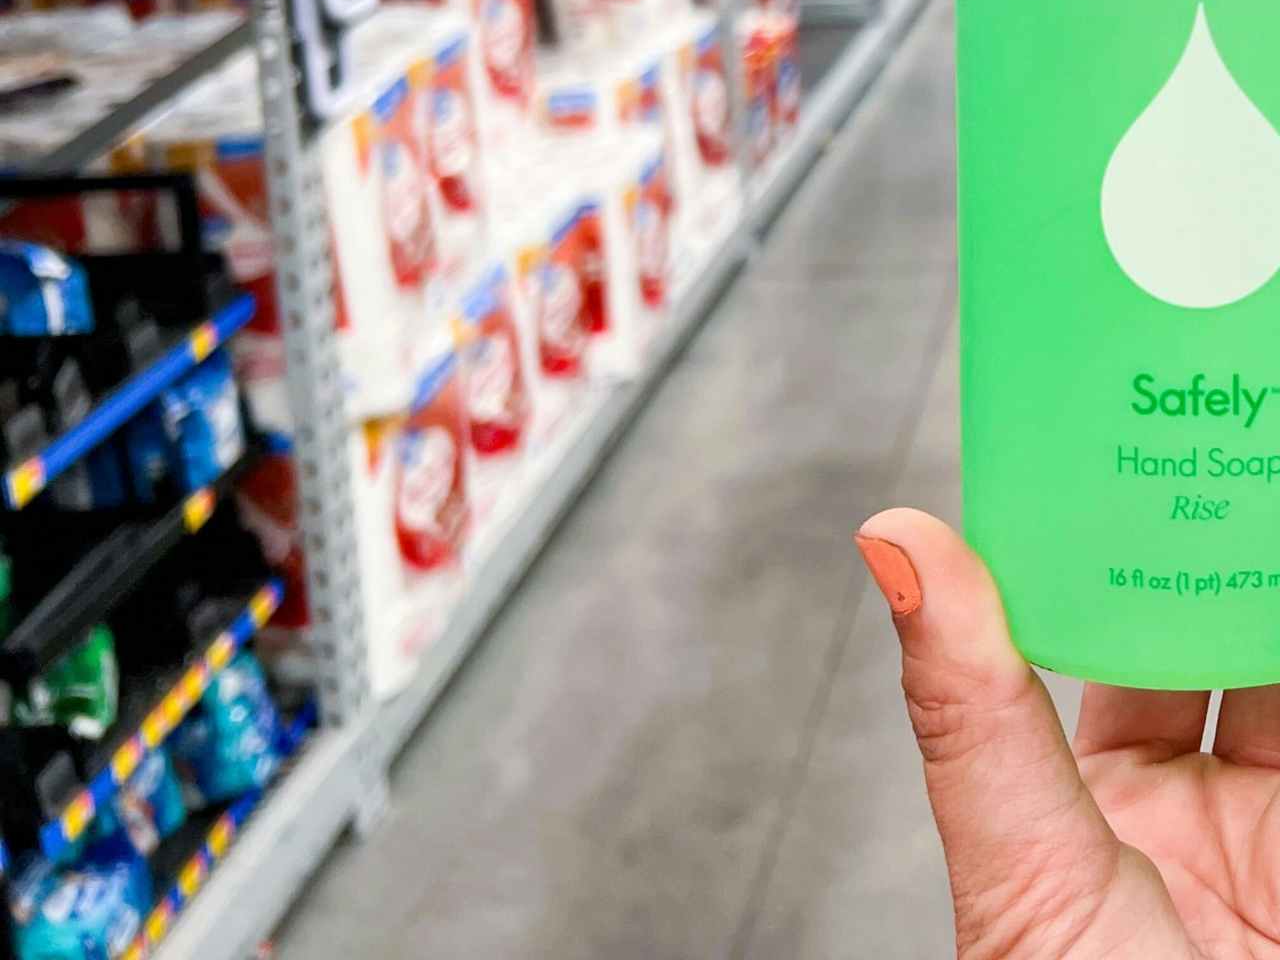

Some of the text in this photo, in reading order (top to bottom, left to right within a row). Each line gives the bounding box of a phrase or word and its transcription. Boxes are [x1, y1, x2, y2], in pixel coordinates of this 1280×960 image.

[1117, 445, 1197, 477] Hand
[1170, 494, 1230, 520] Rise
[1109, 567, 1127, 586] 16
[1131, 568, 1144, 588] fl
[1149, 576, 1171, 590] oz
[1176, 571, 1190, 595] (1
[1195, 571, 1221, 596] pt)
[1225, 570, 1263, 589] 473
